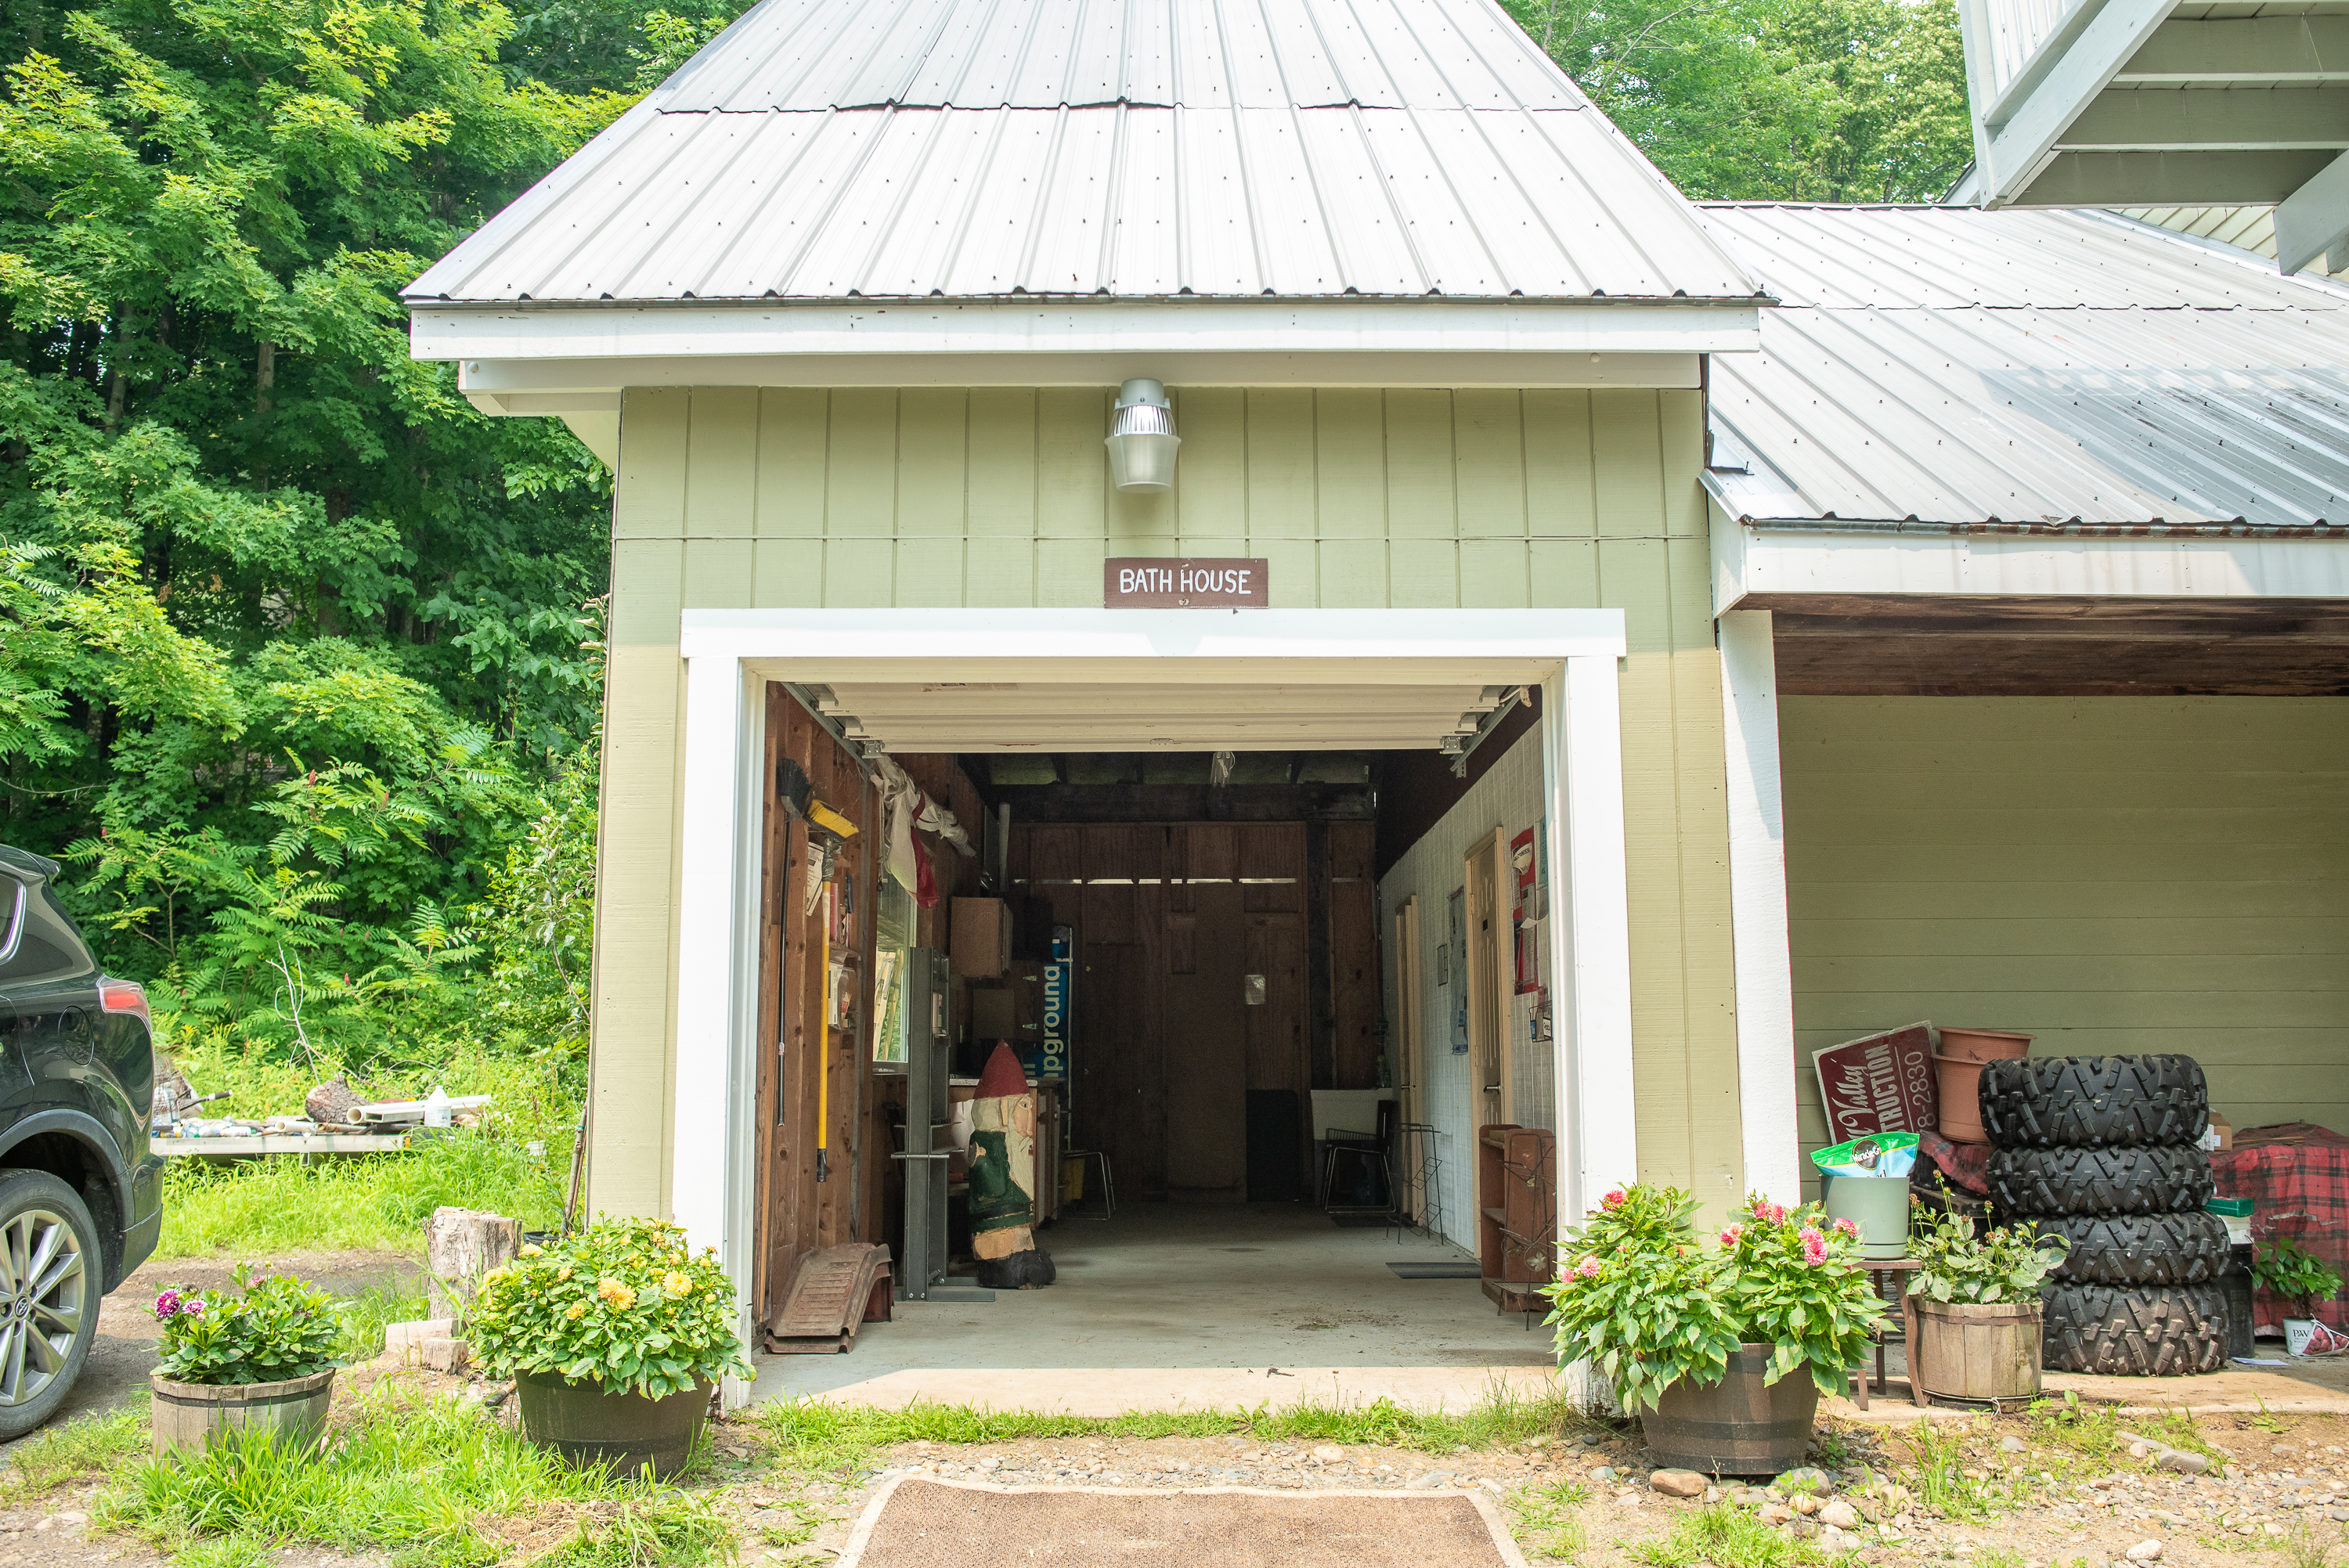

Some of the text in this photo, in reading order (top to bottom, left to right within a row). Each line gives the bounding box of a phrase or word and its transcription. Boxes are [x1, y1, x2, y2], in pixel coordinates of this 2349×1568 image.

[1120, 568, 1252, 594] BATH HOUSE
[1831, 1065, 1875, 1126] Valley
[1865, 1044, 1907, 1132] TRUCTION
